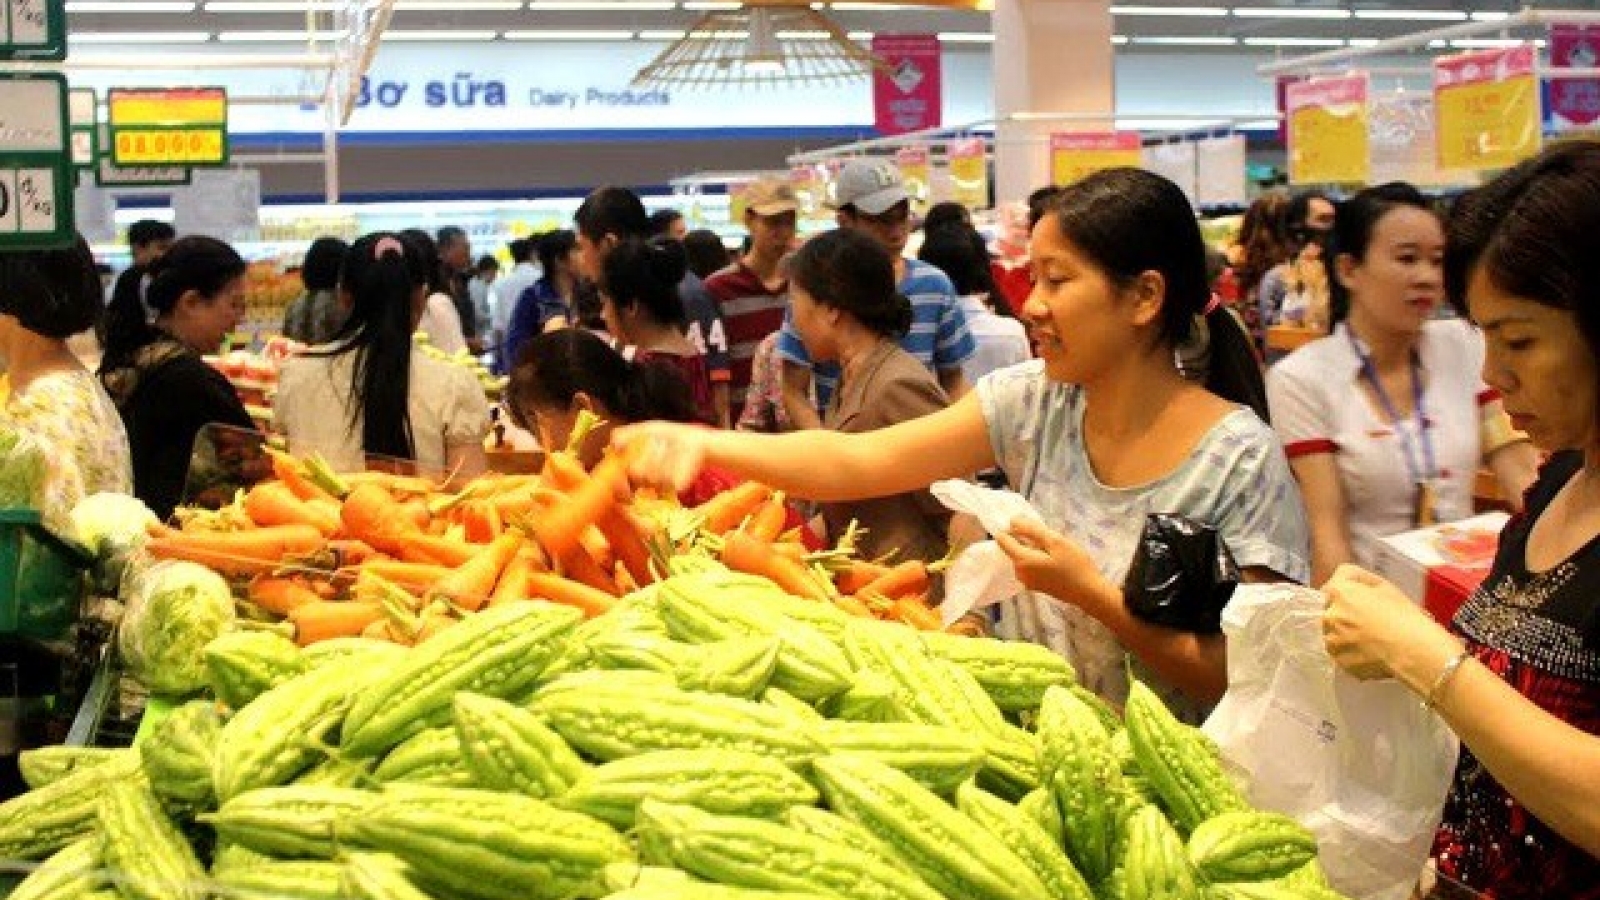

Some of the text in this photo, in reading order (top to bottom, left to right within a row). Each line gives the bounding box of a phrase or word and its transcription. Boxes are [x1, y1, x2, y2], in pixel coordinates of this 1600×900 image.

[424, 71, 507, 107] sữa
[528, 87, 577, 109] Dairy
[585, 86, 671, 106] Products
